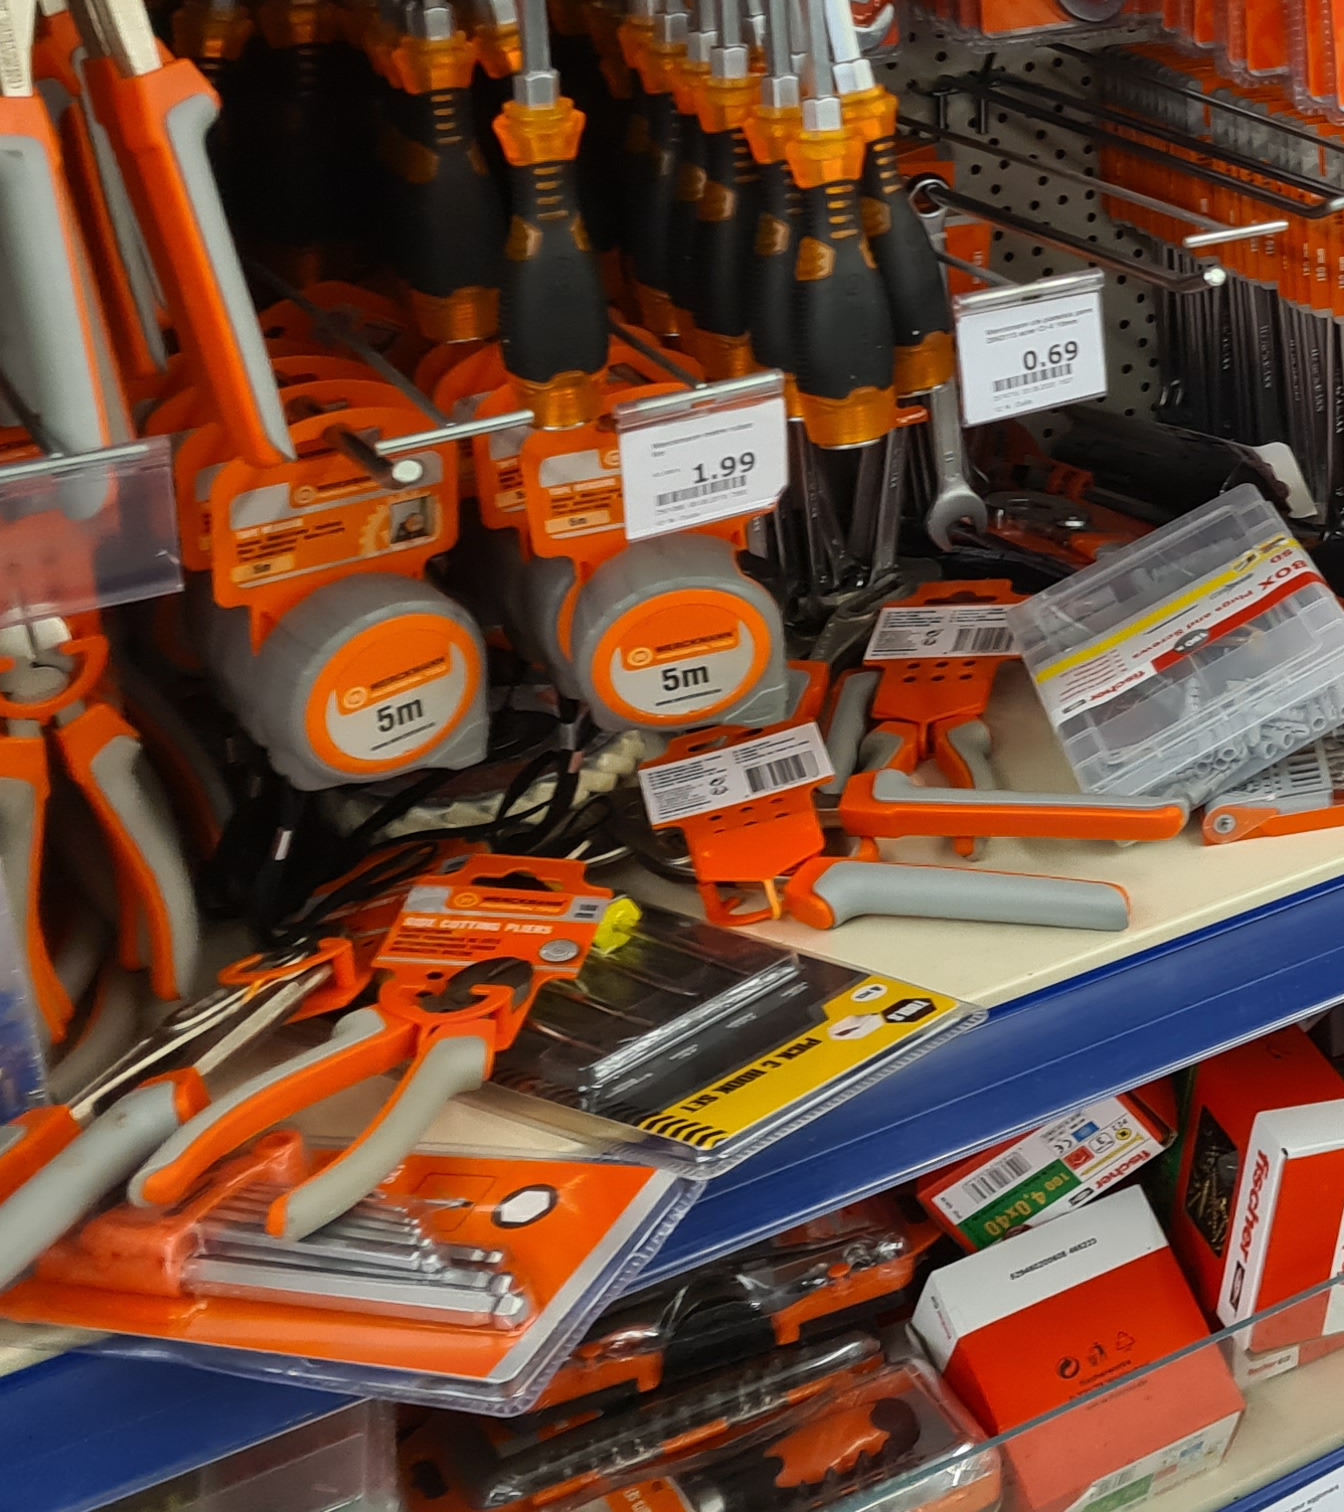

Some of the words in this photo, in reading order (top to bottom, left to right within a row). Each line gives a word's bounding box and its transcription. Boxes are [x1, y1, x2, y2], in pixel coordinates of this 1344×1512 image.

[1023, 341, 1078, 371] 0.69
[692, 452, 756, 483] 1.99
[1257, 559, 1308, 592] BOX
[661, 664, 710, 692] 5m
[1089, 669, 1146, 702] fischer
[376, 698, 424, 733] 5m
[402, 917, 436, 928] SIDE
[439, 919, 501, 932] CUTTING
[504, 923, 554, 935] PLIERS
[1096, 1149, 1151, 1190] fischer
[983, 1192, 1048, 1238] 4,0x40
[1239, 1148, 1270, 1265] fischer
